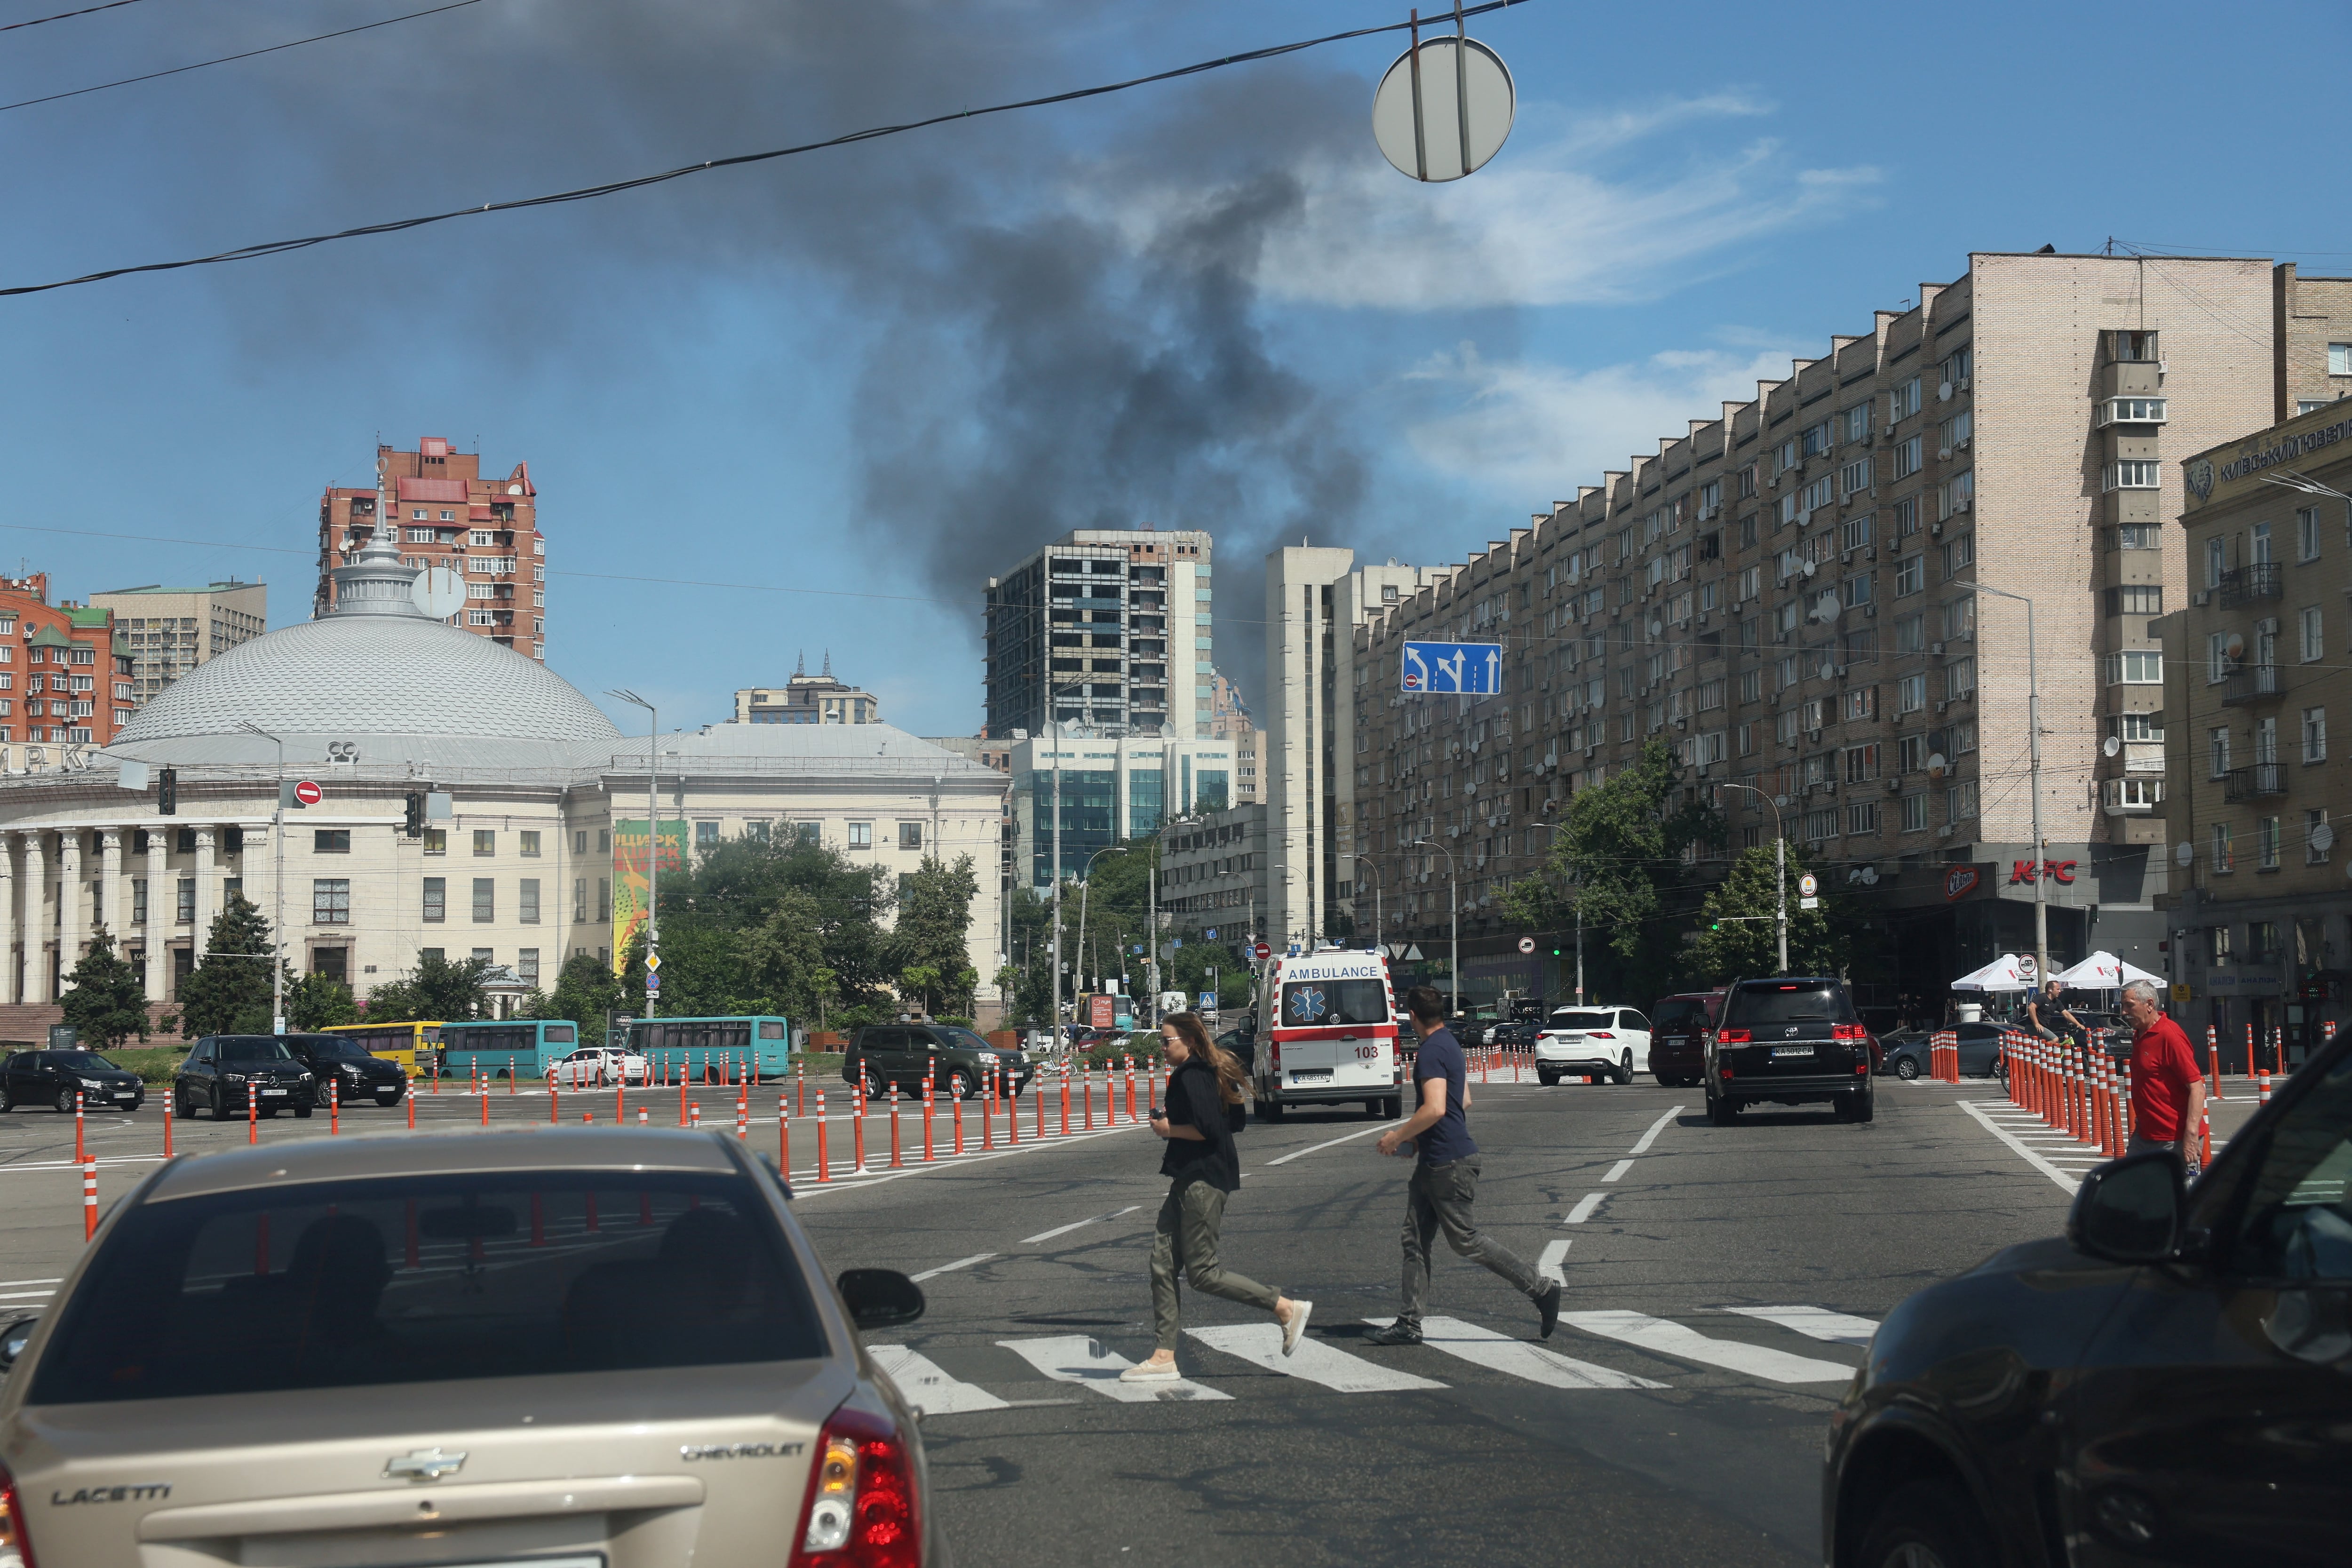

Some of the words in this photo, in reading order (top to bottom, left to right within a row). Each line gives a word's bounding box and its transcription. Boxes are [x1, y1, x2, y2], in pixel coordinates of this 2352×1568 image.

[2221, 436, 2301, 482] КИЇВСЬКИЙ
[621, 835, 680, 847] ЦИРК
[622, 847, 681, 859] ЦИРК
[2010, 860, 2077, 882] KFC
[1948, 870, 1973, 895] Сільпо
[1288, 966, 1377, 979] AMBULANCE
[2209, 976, 2236, 986] АНАЛІЗИ
[1355, 1046, 1378, 1059] 103
[680, 1442, 805, 1462] CHEVROLET
[51, 1482, 173, 1506] LACETTI
